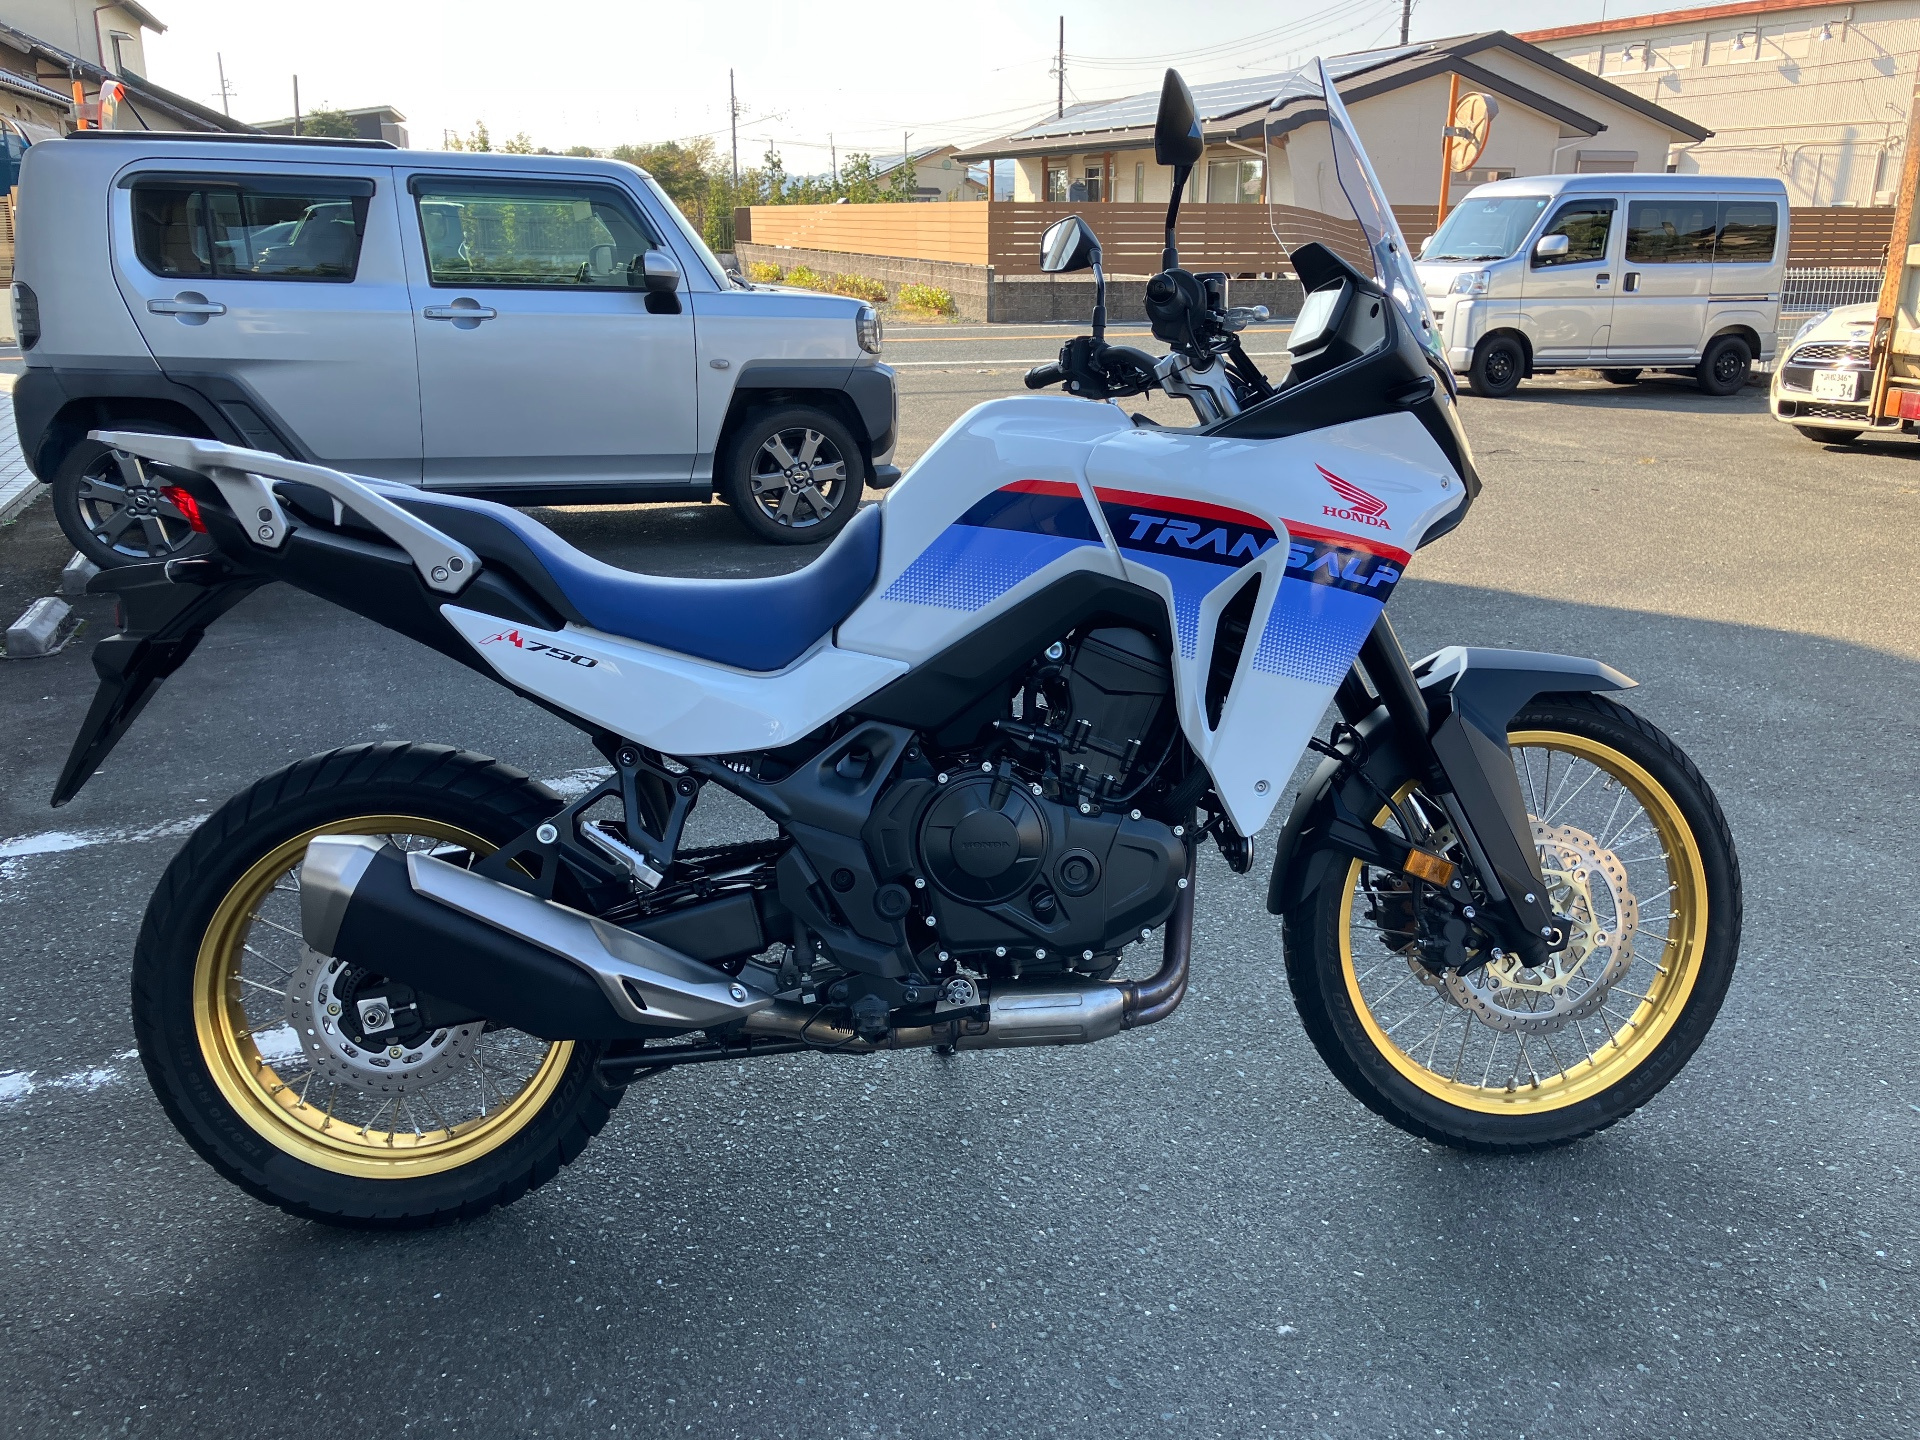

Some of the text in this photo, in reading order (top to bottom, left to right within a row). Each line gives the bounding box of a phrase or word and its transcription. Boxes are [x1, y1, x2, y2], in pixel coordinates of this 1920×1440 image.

[1322, 505, 1392, 531] HONDA
[1129, 514, 1400, 588] TRANSALP
[525, 640, 599, 668] 750
[962, 841, 1011, 849] HONDA
